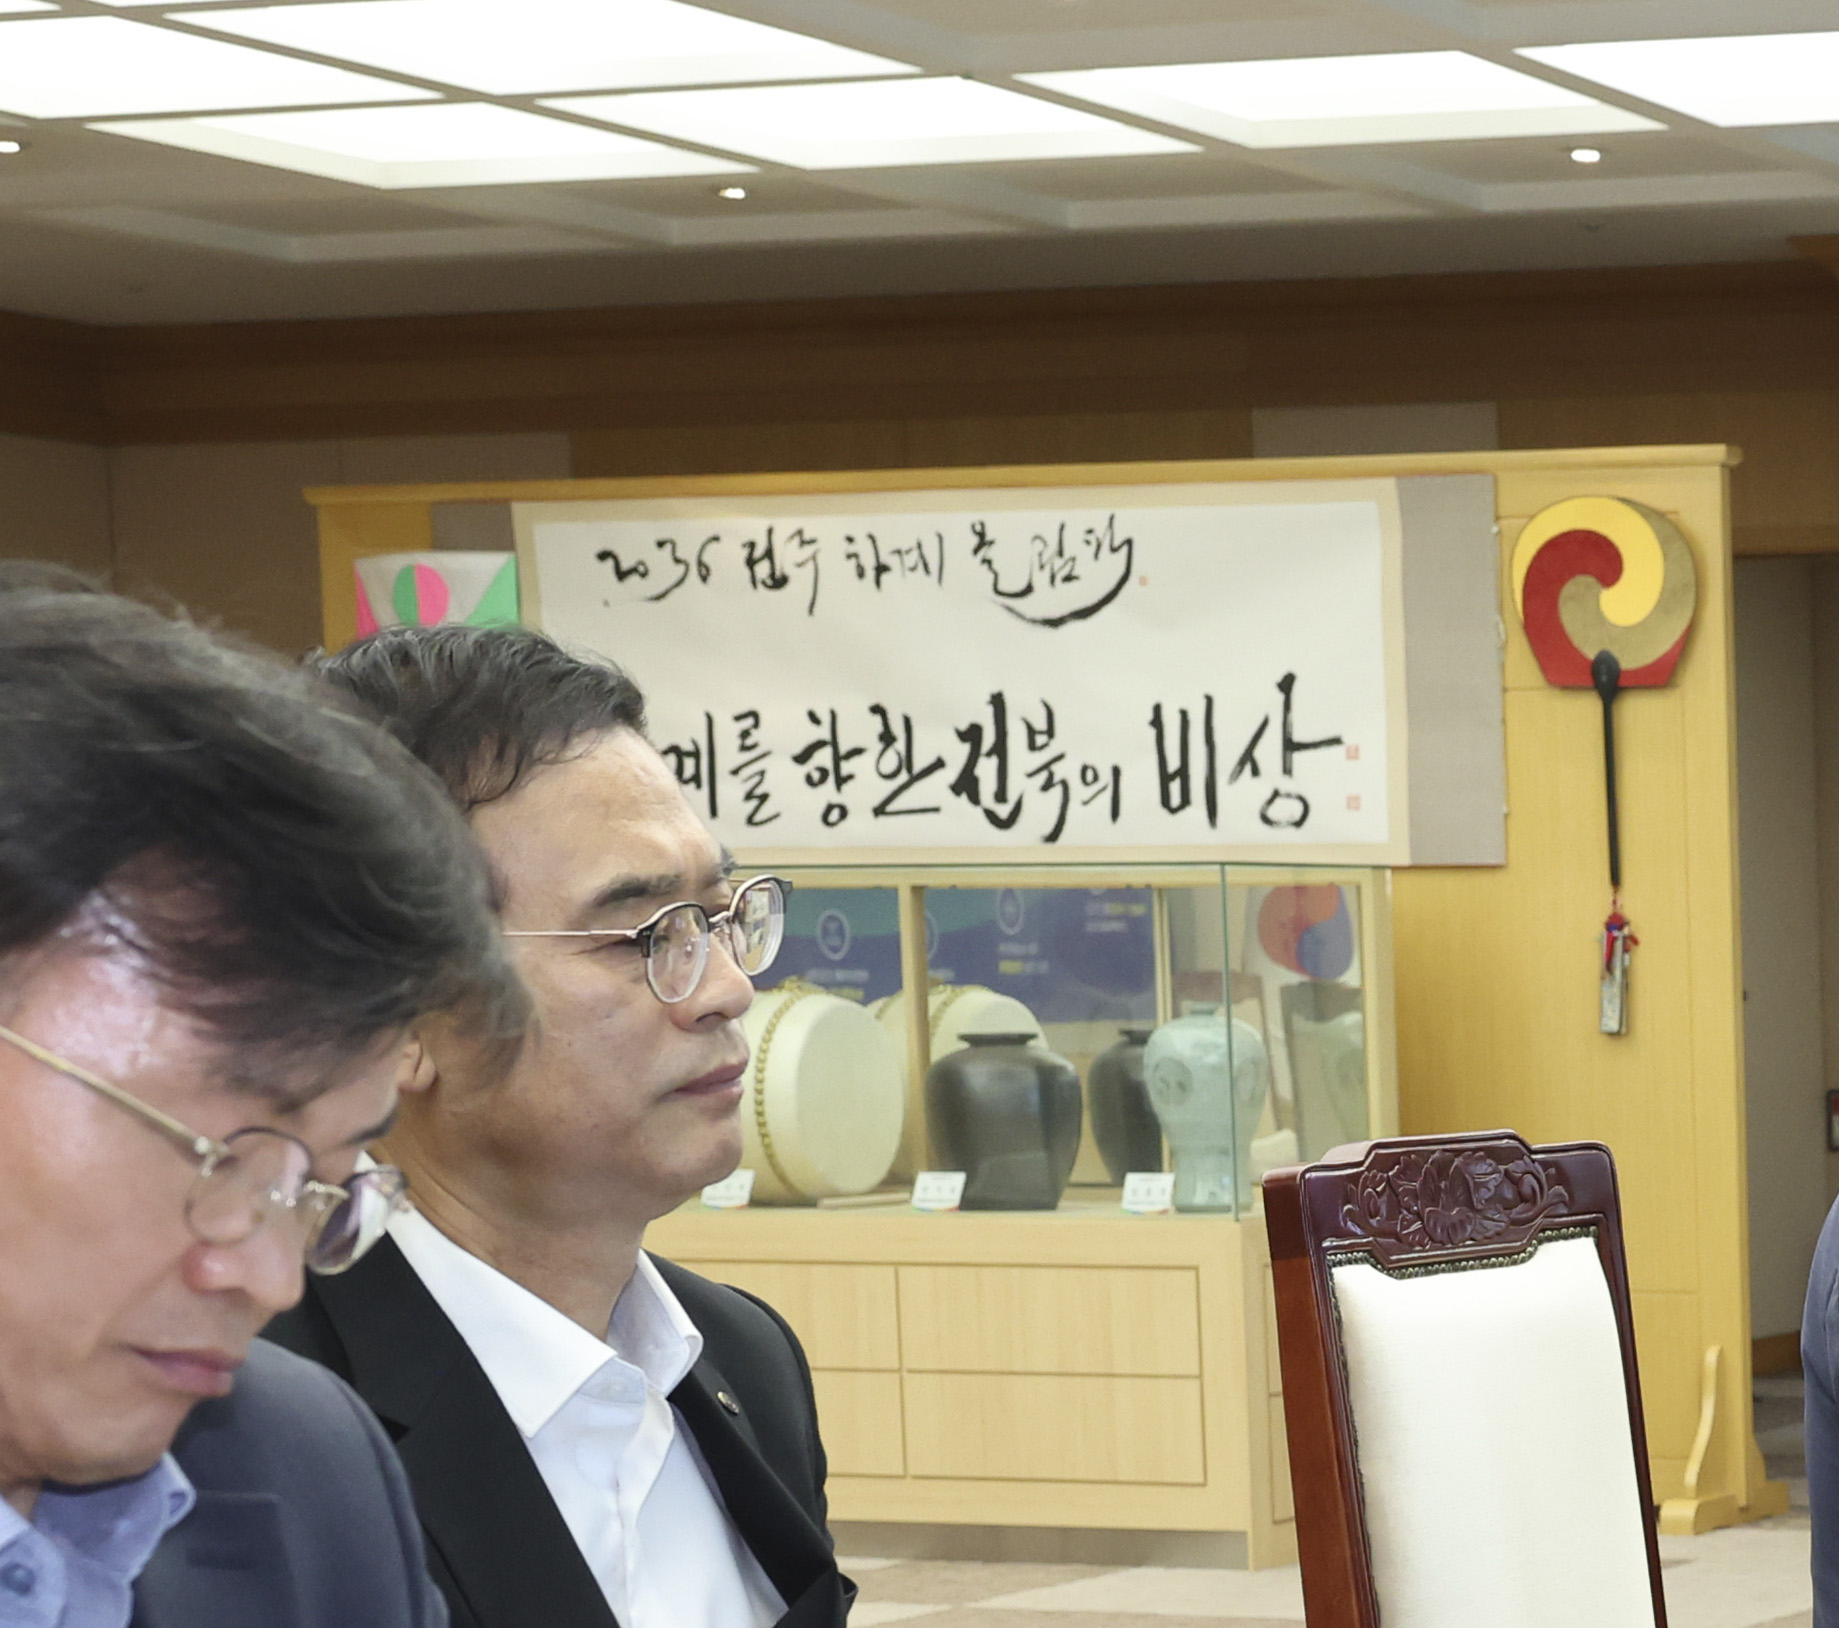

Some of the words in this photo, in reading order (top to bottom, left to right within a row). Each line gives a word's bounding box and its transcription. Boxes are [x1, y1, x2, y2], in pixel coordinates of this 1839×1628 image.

[742, 525, 820, 616] 전주
[845, 532, 944, 589] 하계
[969, 513, 1134, 628] 올림픽
[661, 706, 781, 828] 계를
[792, 702, 945, 828] 향한
[949, 690, 1121, 843] 전북의
[1148, 671, 1344, 830] 비상
